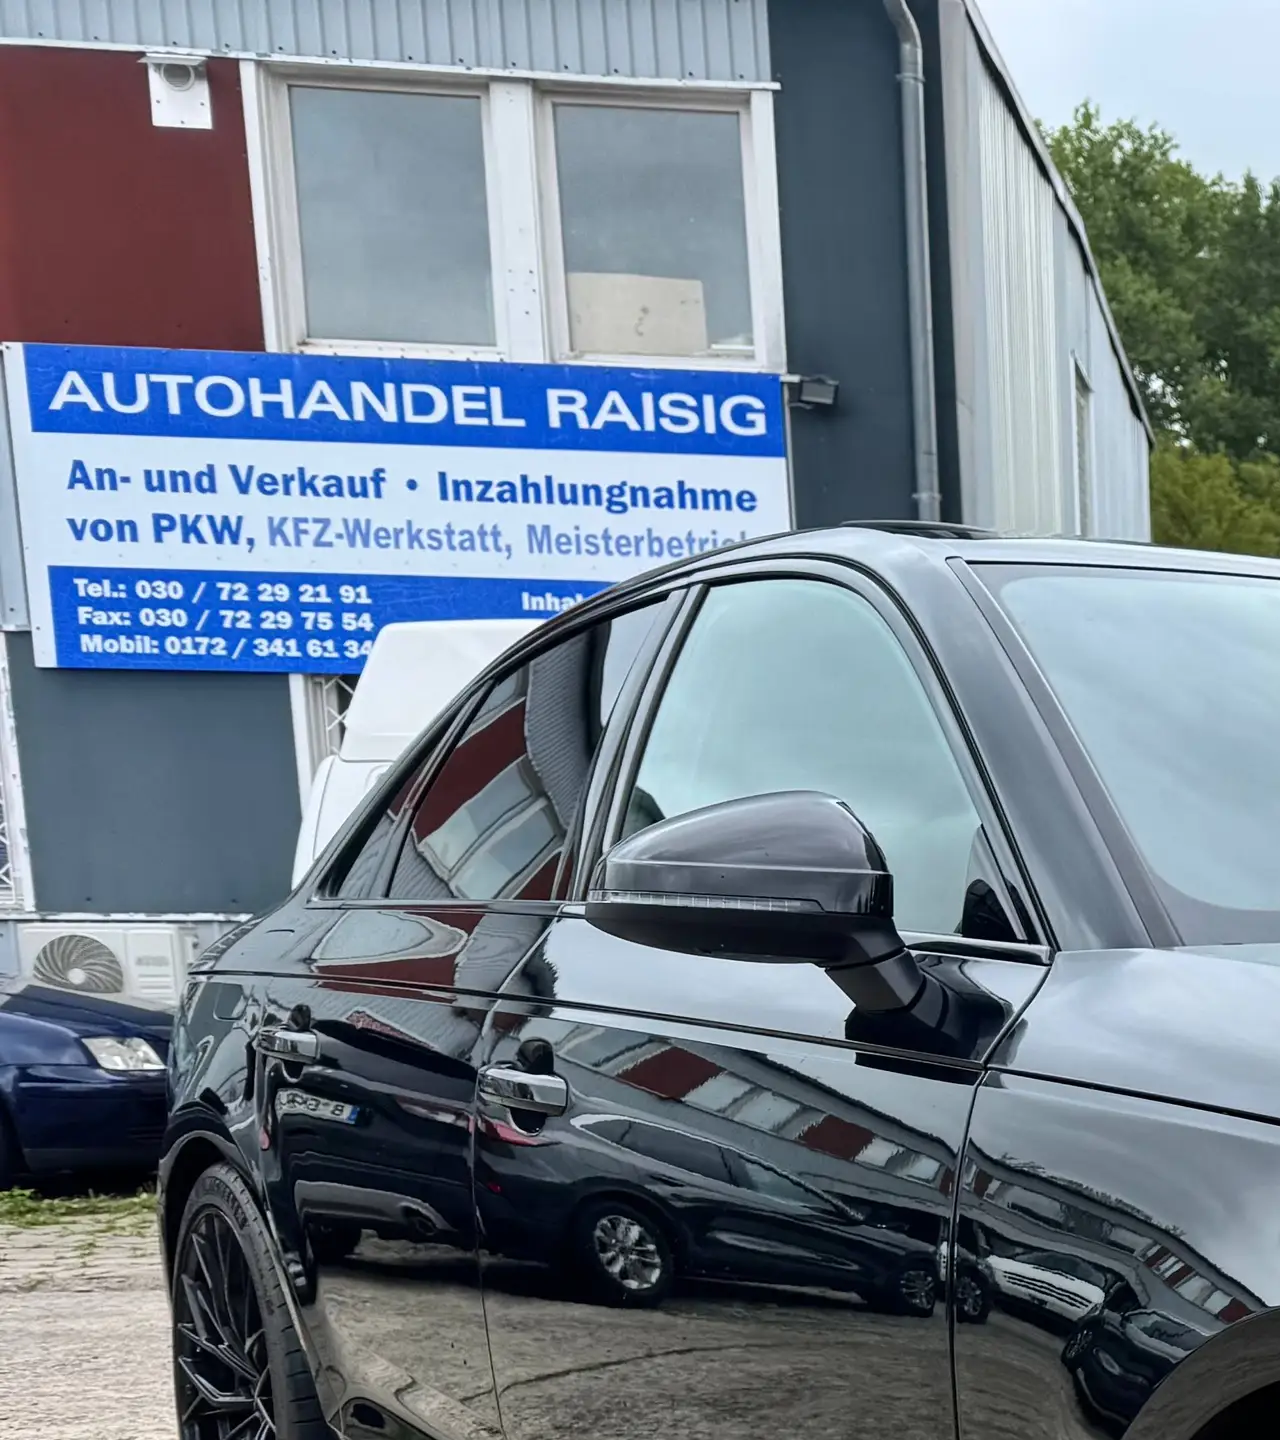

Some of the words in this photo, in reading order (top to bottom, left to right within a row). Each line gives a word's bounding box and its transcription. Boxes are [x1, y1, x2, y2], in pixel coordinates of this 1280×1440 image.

[48, 370, 526, 428] AUTOHANDEL
[546, 387, 768, 437] RAISIG
[66, 458, 131, 491] An-
[143, 463, 217, 494] und
[228, 463, 386, 499] Verkauf
[437, 470, 758, 514] Inzahlungnahme
[66, 516, 139, 543] von
[151, 512, 256, 554] PKW,
[266, 514, 513, 560] KFZ-Werkstatt,
[73, 577, 127, 599] Tel.:
[134, 579, 184, 601] 030
[191, 581, 207, 604] /
[215, 582, 249, 601] 72
[257, 583, 290, 602] 29
[298, 584, 332, 604] 21
[339, 584, 373, 604] 91
[76, 605, 132, 627] Fax:
[138, 606, 188, 628] 030
[194, 609, 210, 632] /
[218, 610, 252, 629] 72
[259, 610, 293, 630] 29
[300, 612, 334, 631] 75
[341, 612, 375, 632] 54
[79, 633, 160, 656] Mobil:
[164, 635, 228, 657] 0172
[230, 637, 247, 660] /
[252, 638, 303, 659] 341
[306, 638, 340, 659] 61
[343, 639, 372, 660] 34
